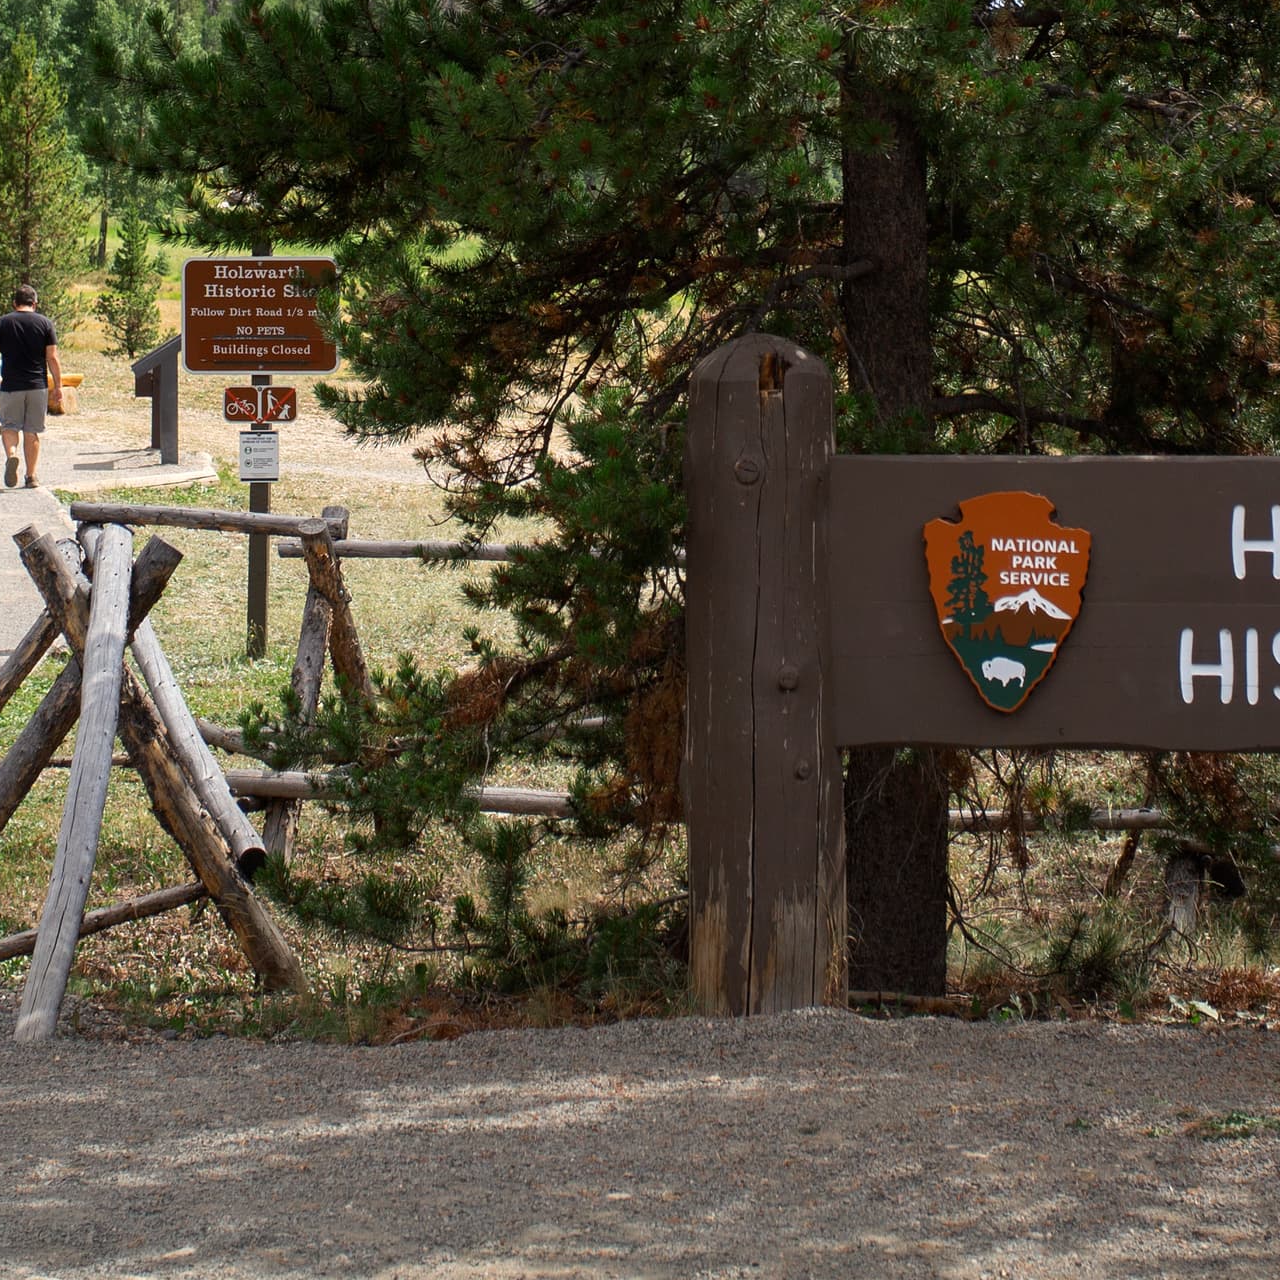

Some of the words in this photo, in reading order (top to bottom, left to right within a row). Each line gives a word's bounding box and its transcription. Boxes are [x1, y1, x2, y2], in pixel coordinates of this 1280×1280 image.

[214, 265, 305, 279] Holzwarth
[203, 284, 276, 298] Historic
[190, 307, 225, 317] Follow
[229, 307, 252, 317] Dirt
[256, 307, 282, 317] Road
[286, 306, 304, 318] 1/2
[236, 326, 253, 336] NO
[257, 326, 286, 336] PETS
[212, 344, 269, 357] Buildings
[271, 344, 311, 355] Closed
[990, 538, 1080, 554] NATIONAL
[1012, 555, 1057, 570] PARK
[999, 571, 1071, 587] SERVICE
